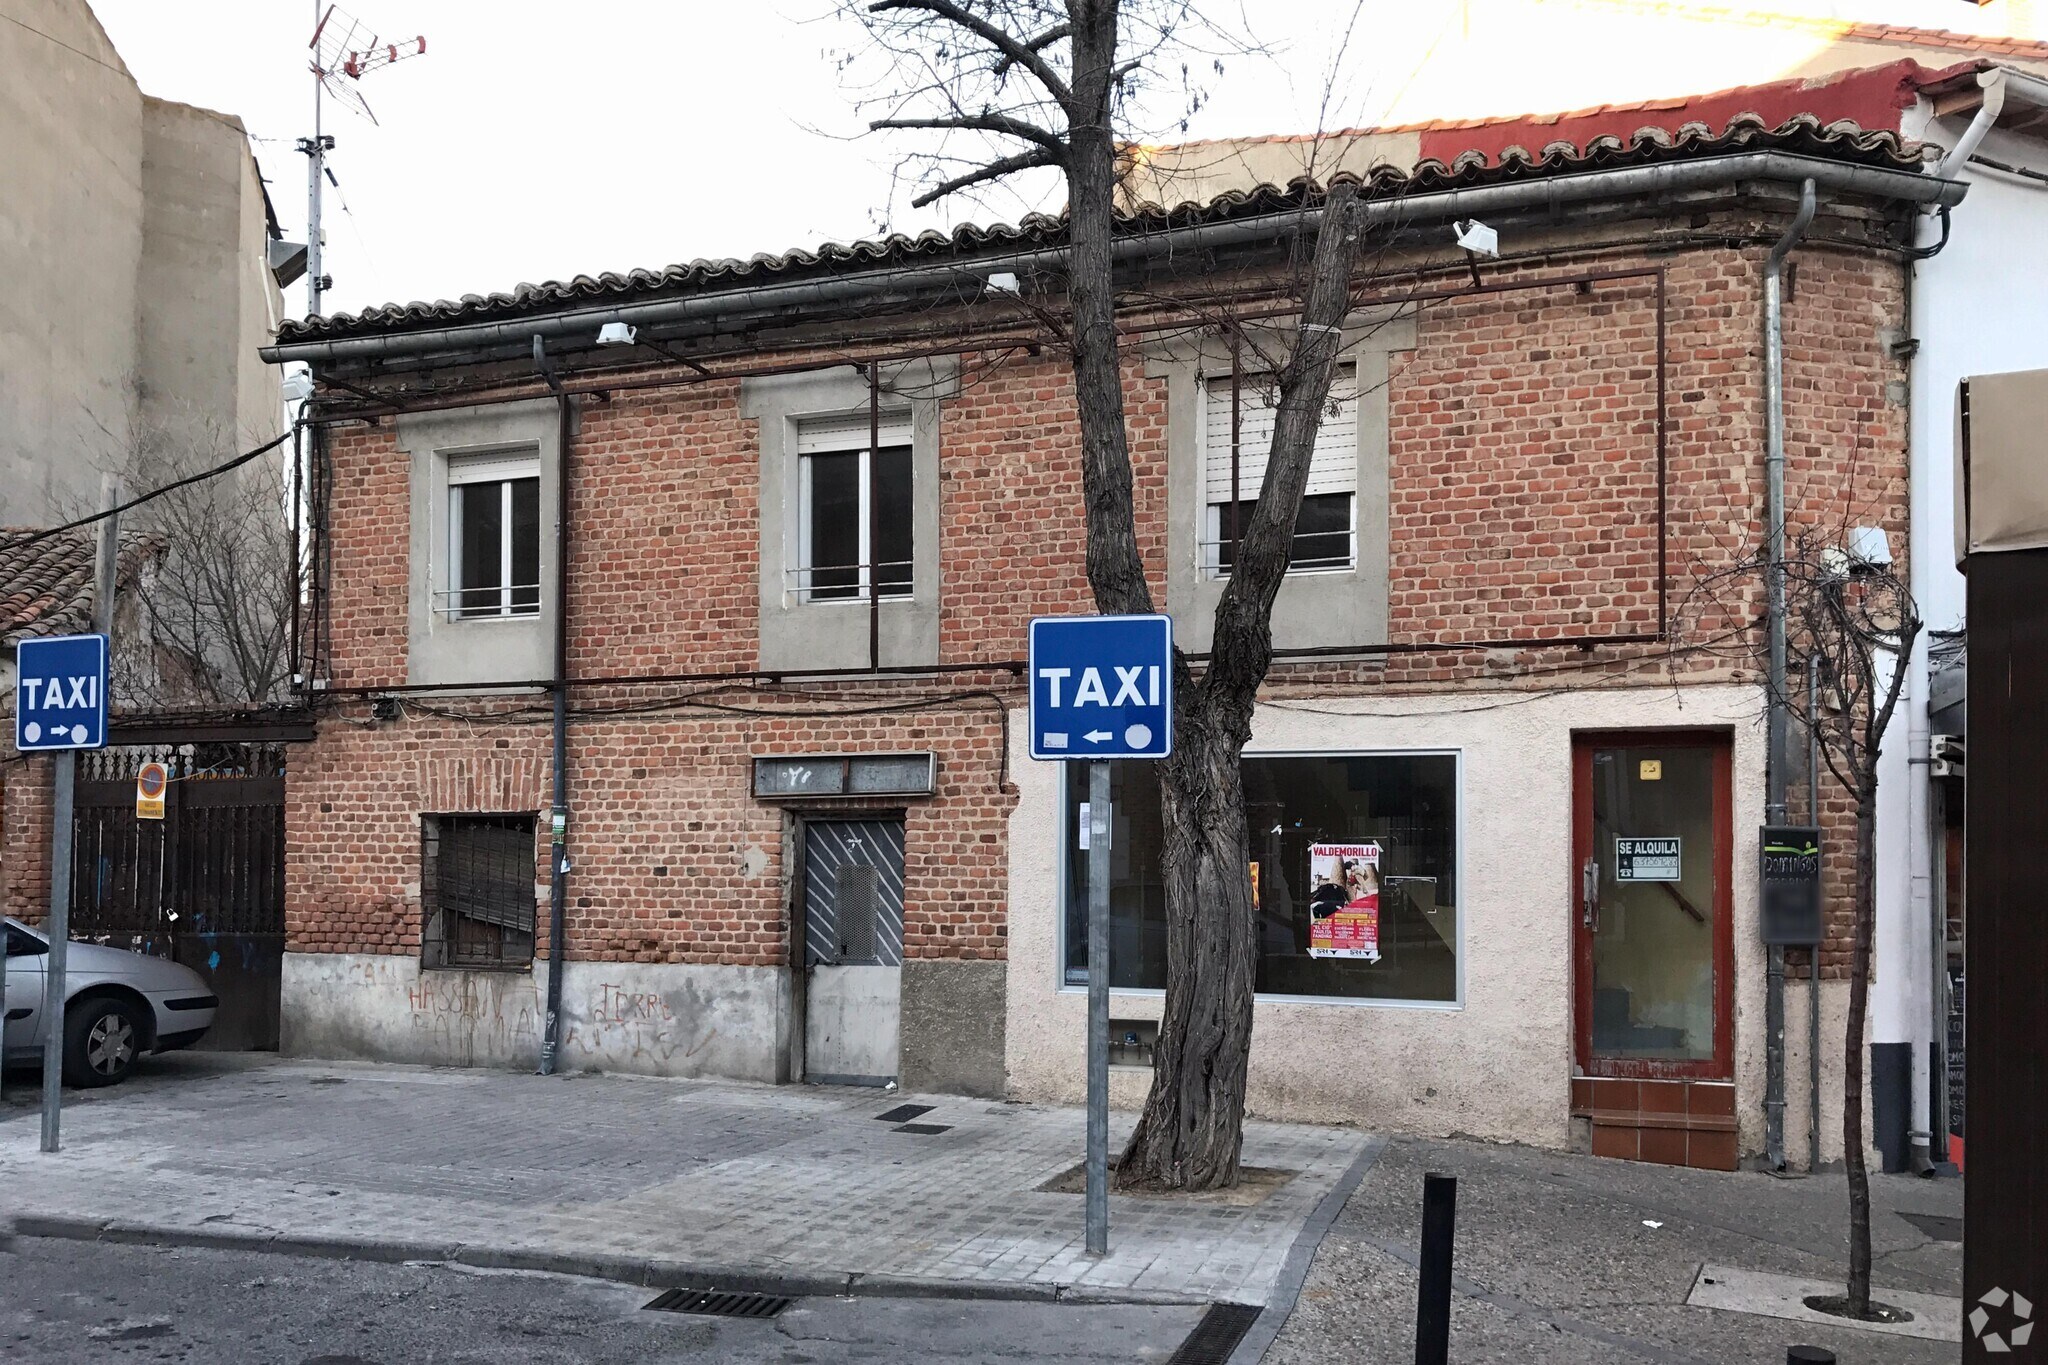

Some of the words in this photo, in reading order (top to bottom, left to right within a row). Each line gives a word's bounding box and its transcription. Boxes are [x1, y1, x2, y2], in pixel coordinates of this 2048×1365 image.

[22, 676, 97, 710] TAXI
[1039, 665, 1160, 708] TAXI
[1313, 846, 1377, 857] VALDEMORILLO
[1619, 842, 1632, 854] SE
[1634, 842, 1677, 855] ALQUILA
[1764, 856, 1817, 874] DOMINGOS
